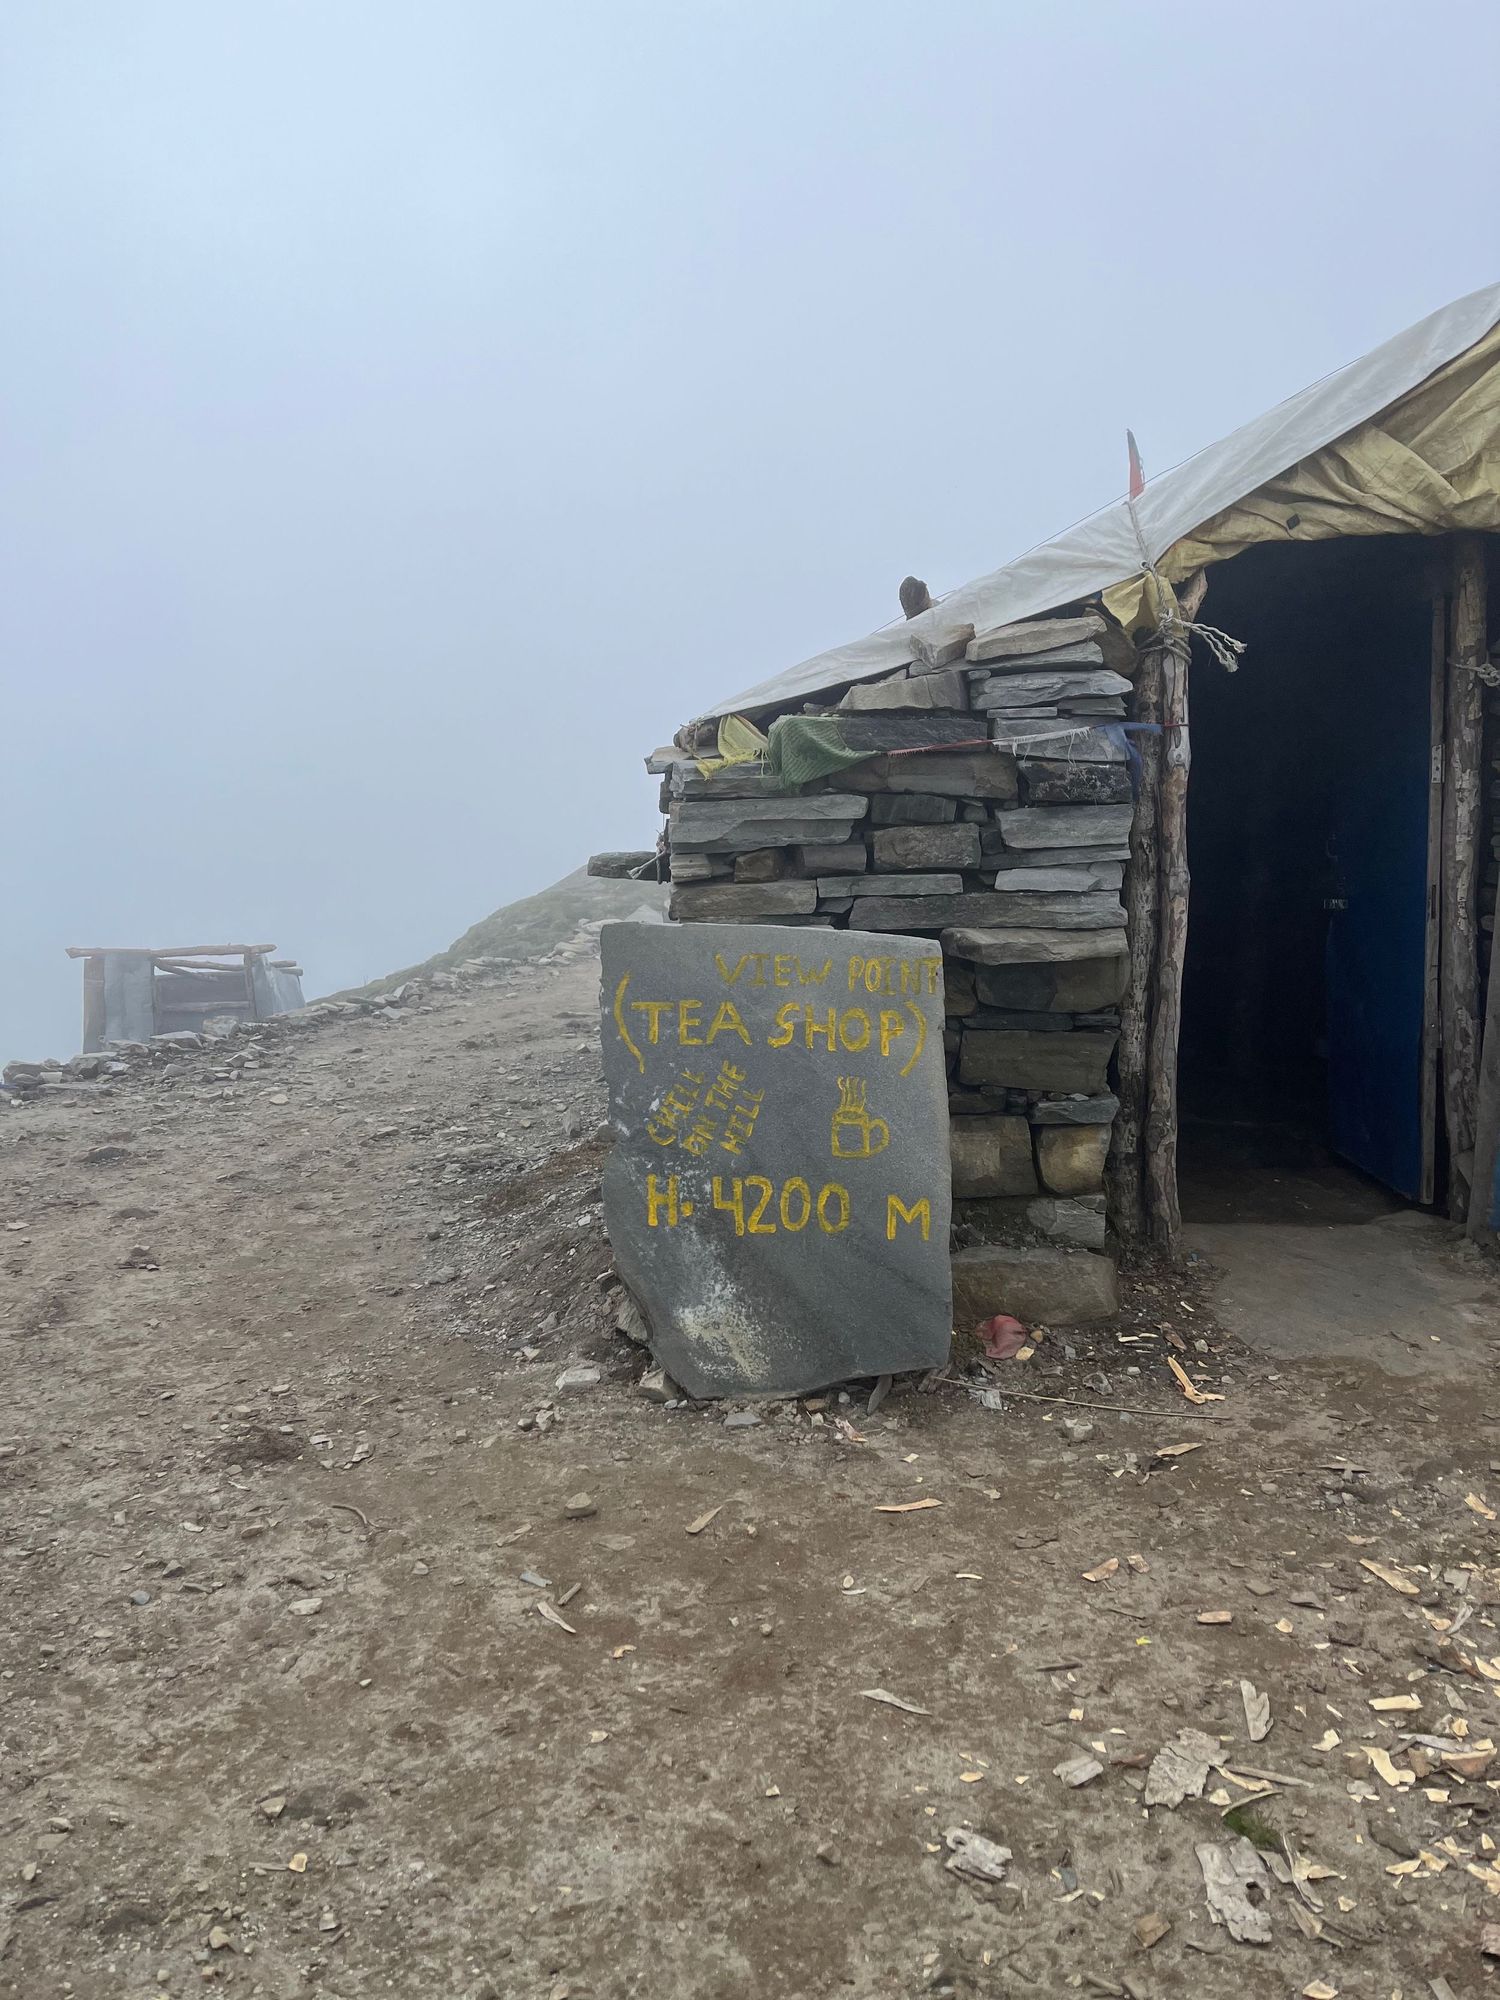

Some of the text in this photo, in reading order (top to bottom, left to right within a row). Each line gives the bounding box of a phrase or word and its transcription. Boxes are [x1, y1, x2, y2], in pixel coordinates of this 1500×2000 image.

[715, 953, 941, 996] VIEW POINT
[646, 1071, 705, 1146] CHILL
[682, 1060, 747, 1156] ON THE
[719, 1088, 765, 1155] HILL
[647, 1173, 930, 1240] H. 4200 M
